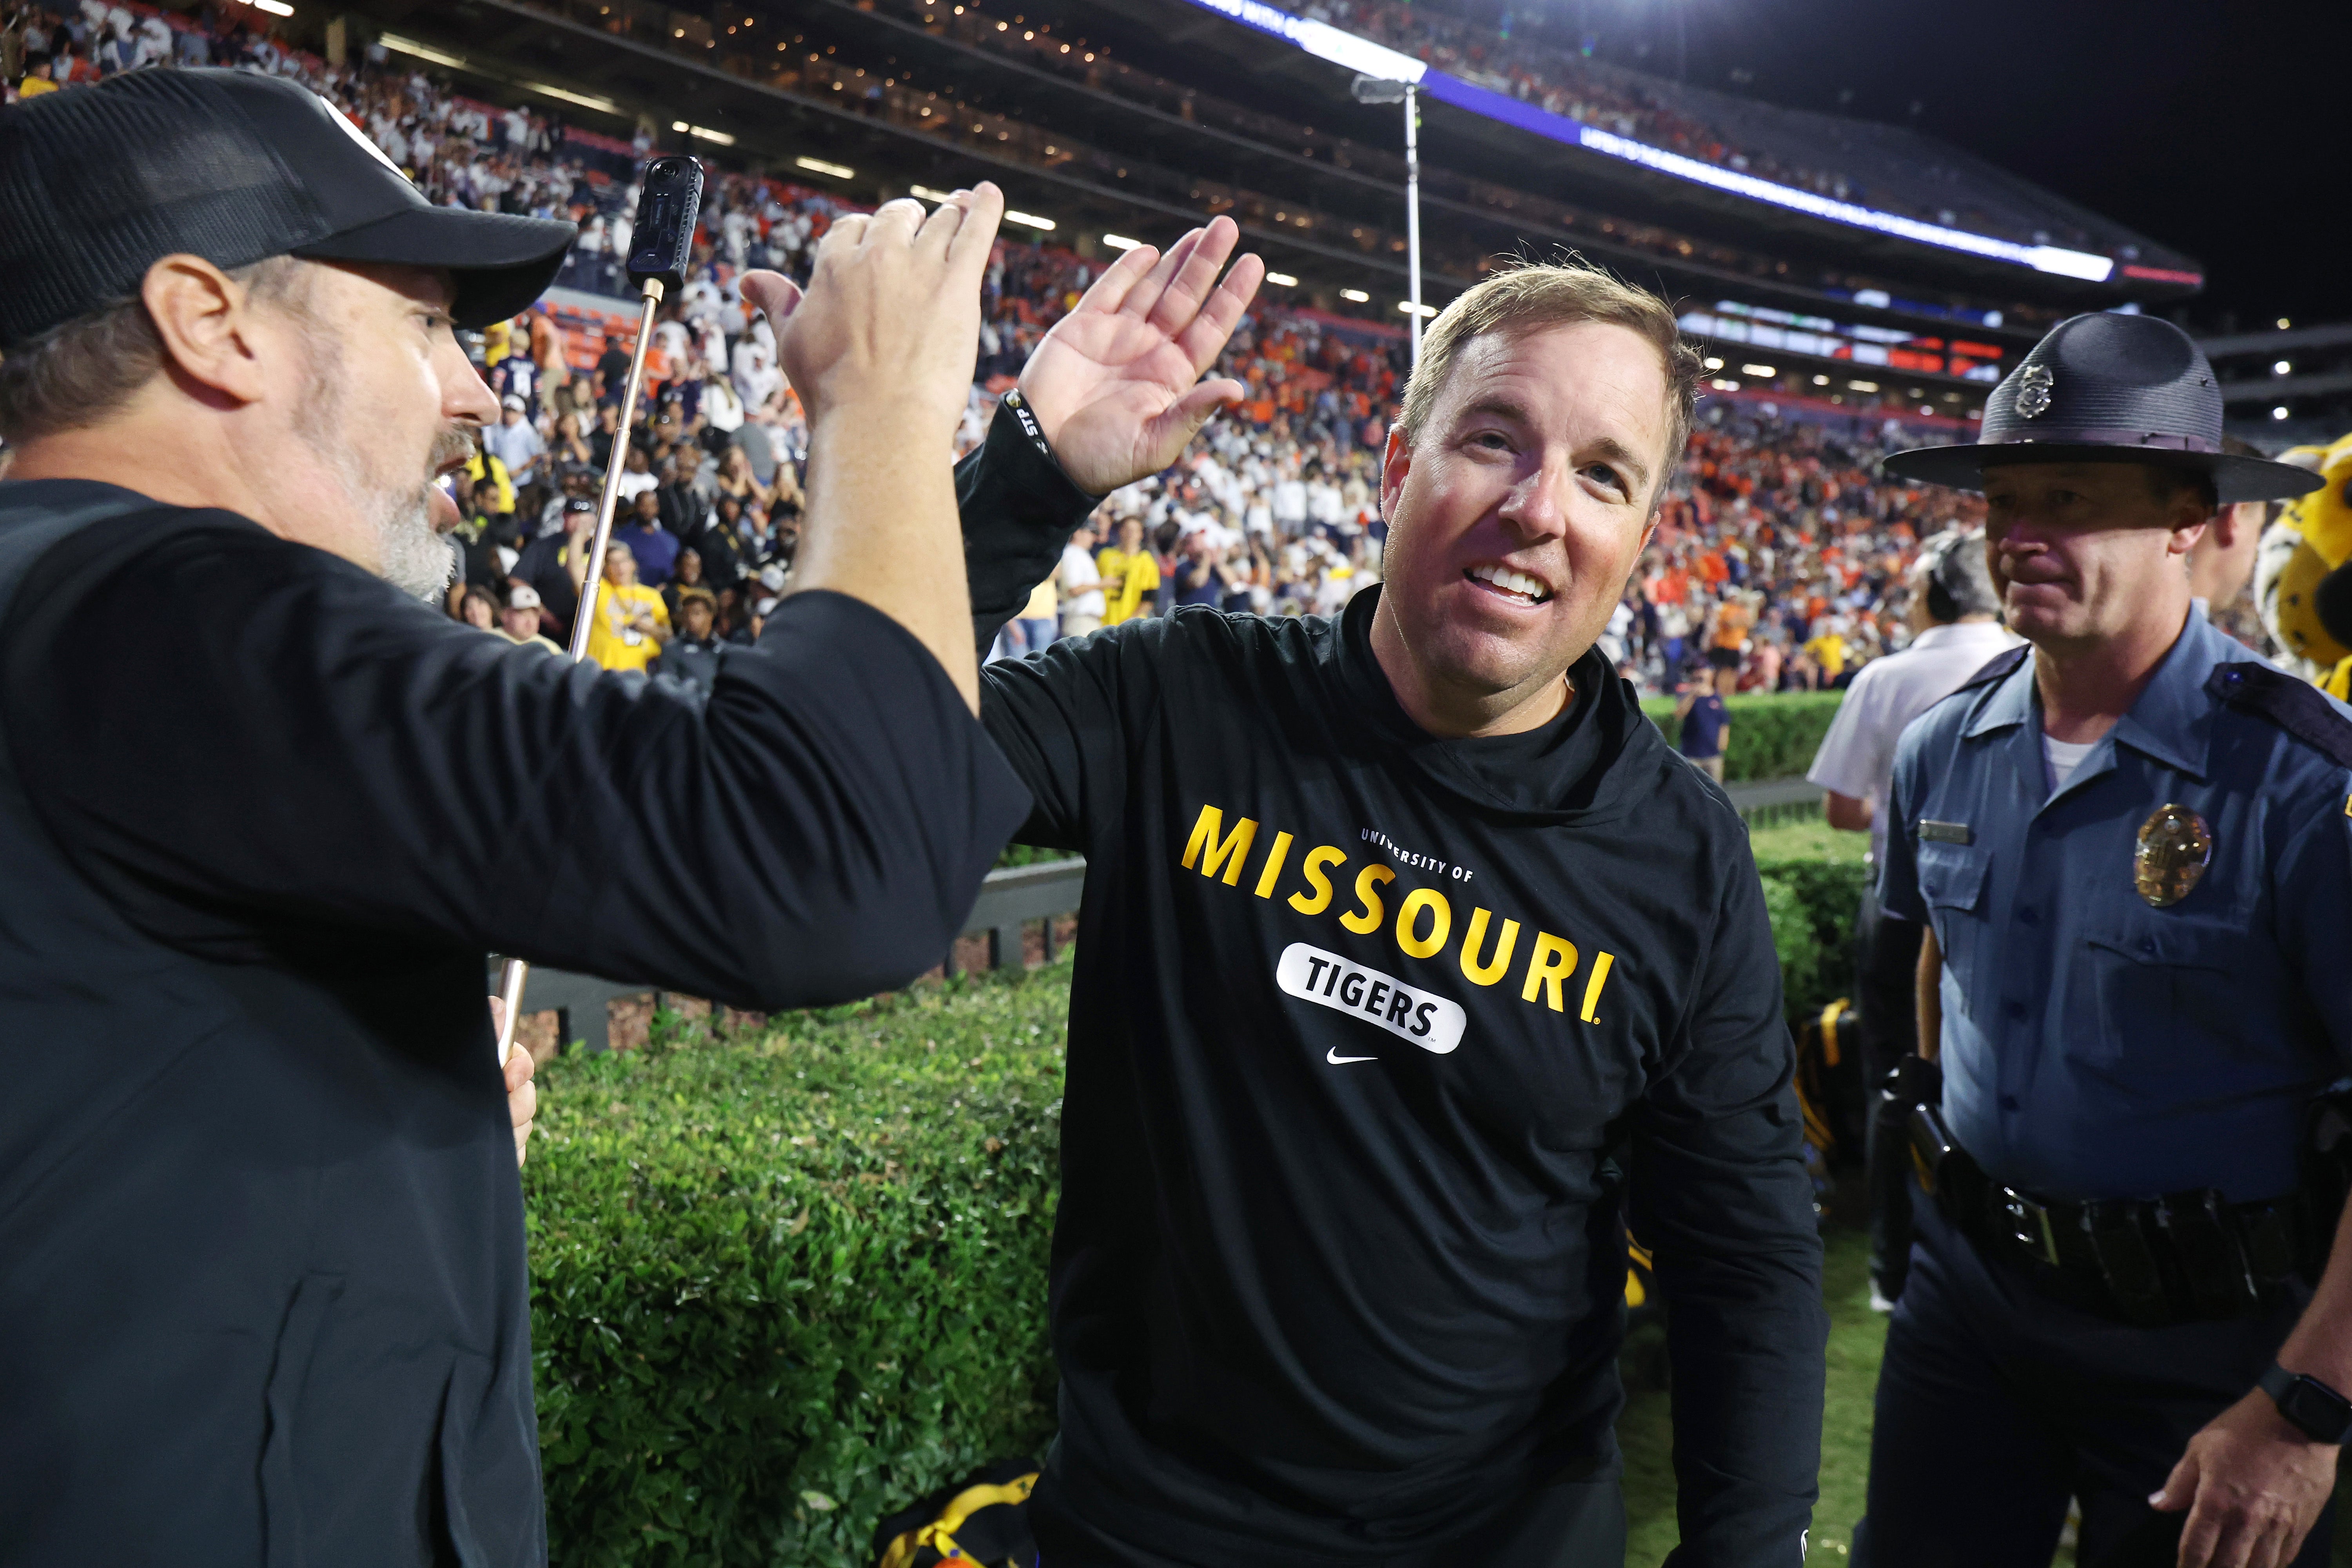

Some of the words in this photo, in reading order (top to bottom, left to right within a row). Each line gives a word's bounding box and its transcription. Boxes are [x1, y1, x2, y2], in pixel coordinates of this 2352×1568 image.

[1016, 408, 1038, 437] STP
[1361, 828, 1446, 874] UNIVERSITY
[1452, 866, 1473, 882] OF
[1181, 804, 1615, 1023] MISSOURI
[1306, 956, 1438, 1036] TIGERS
